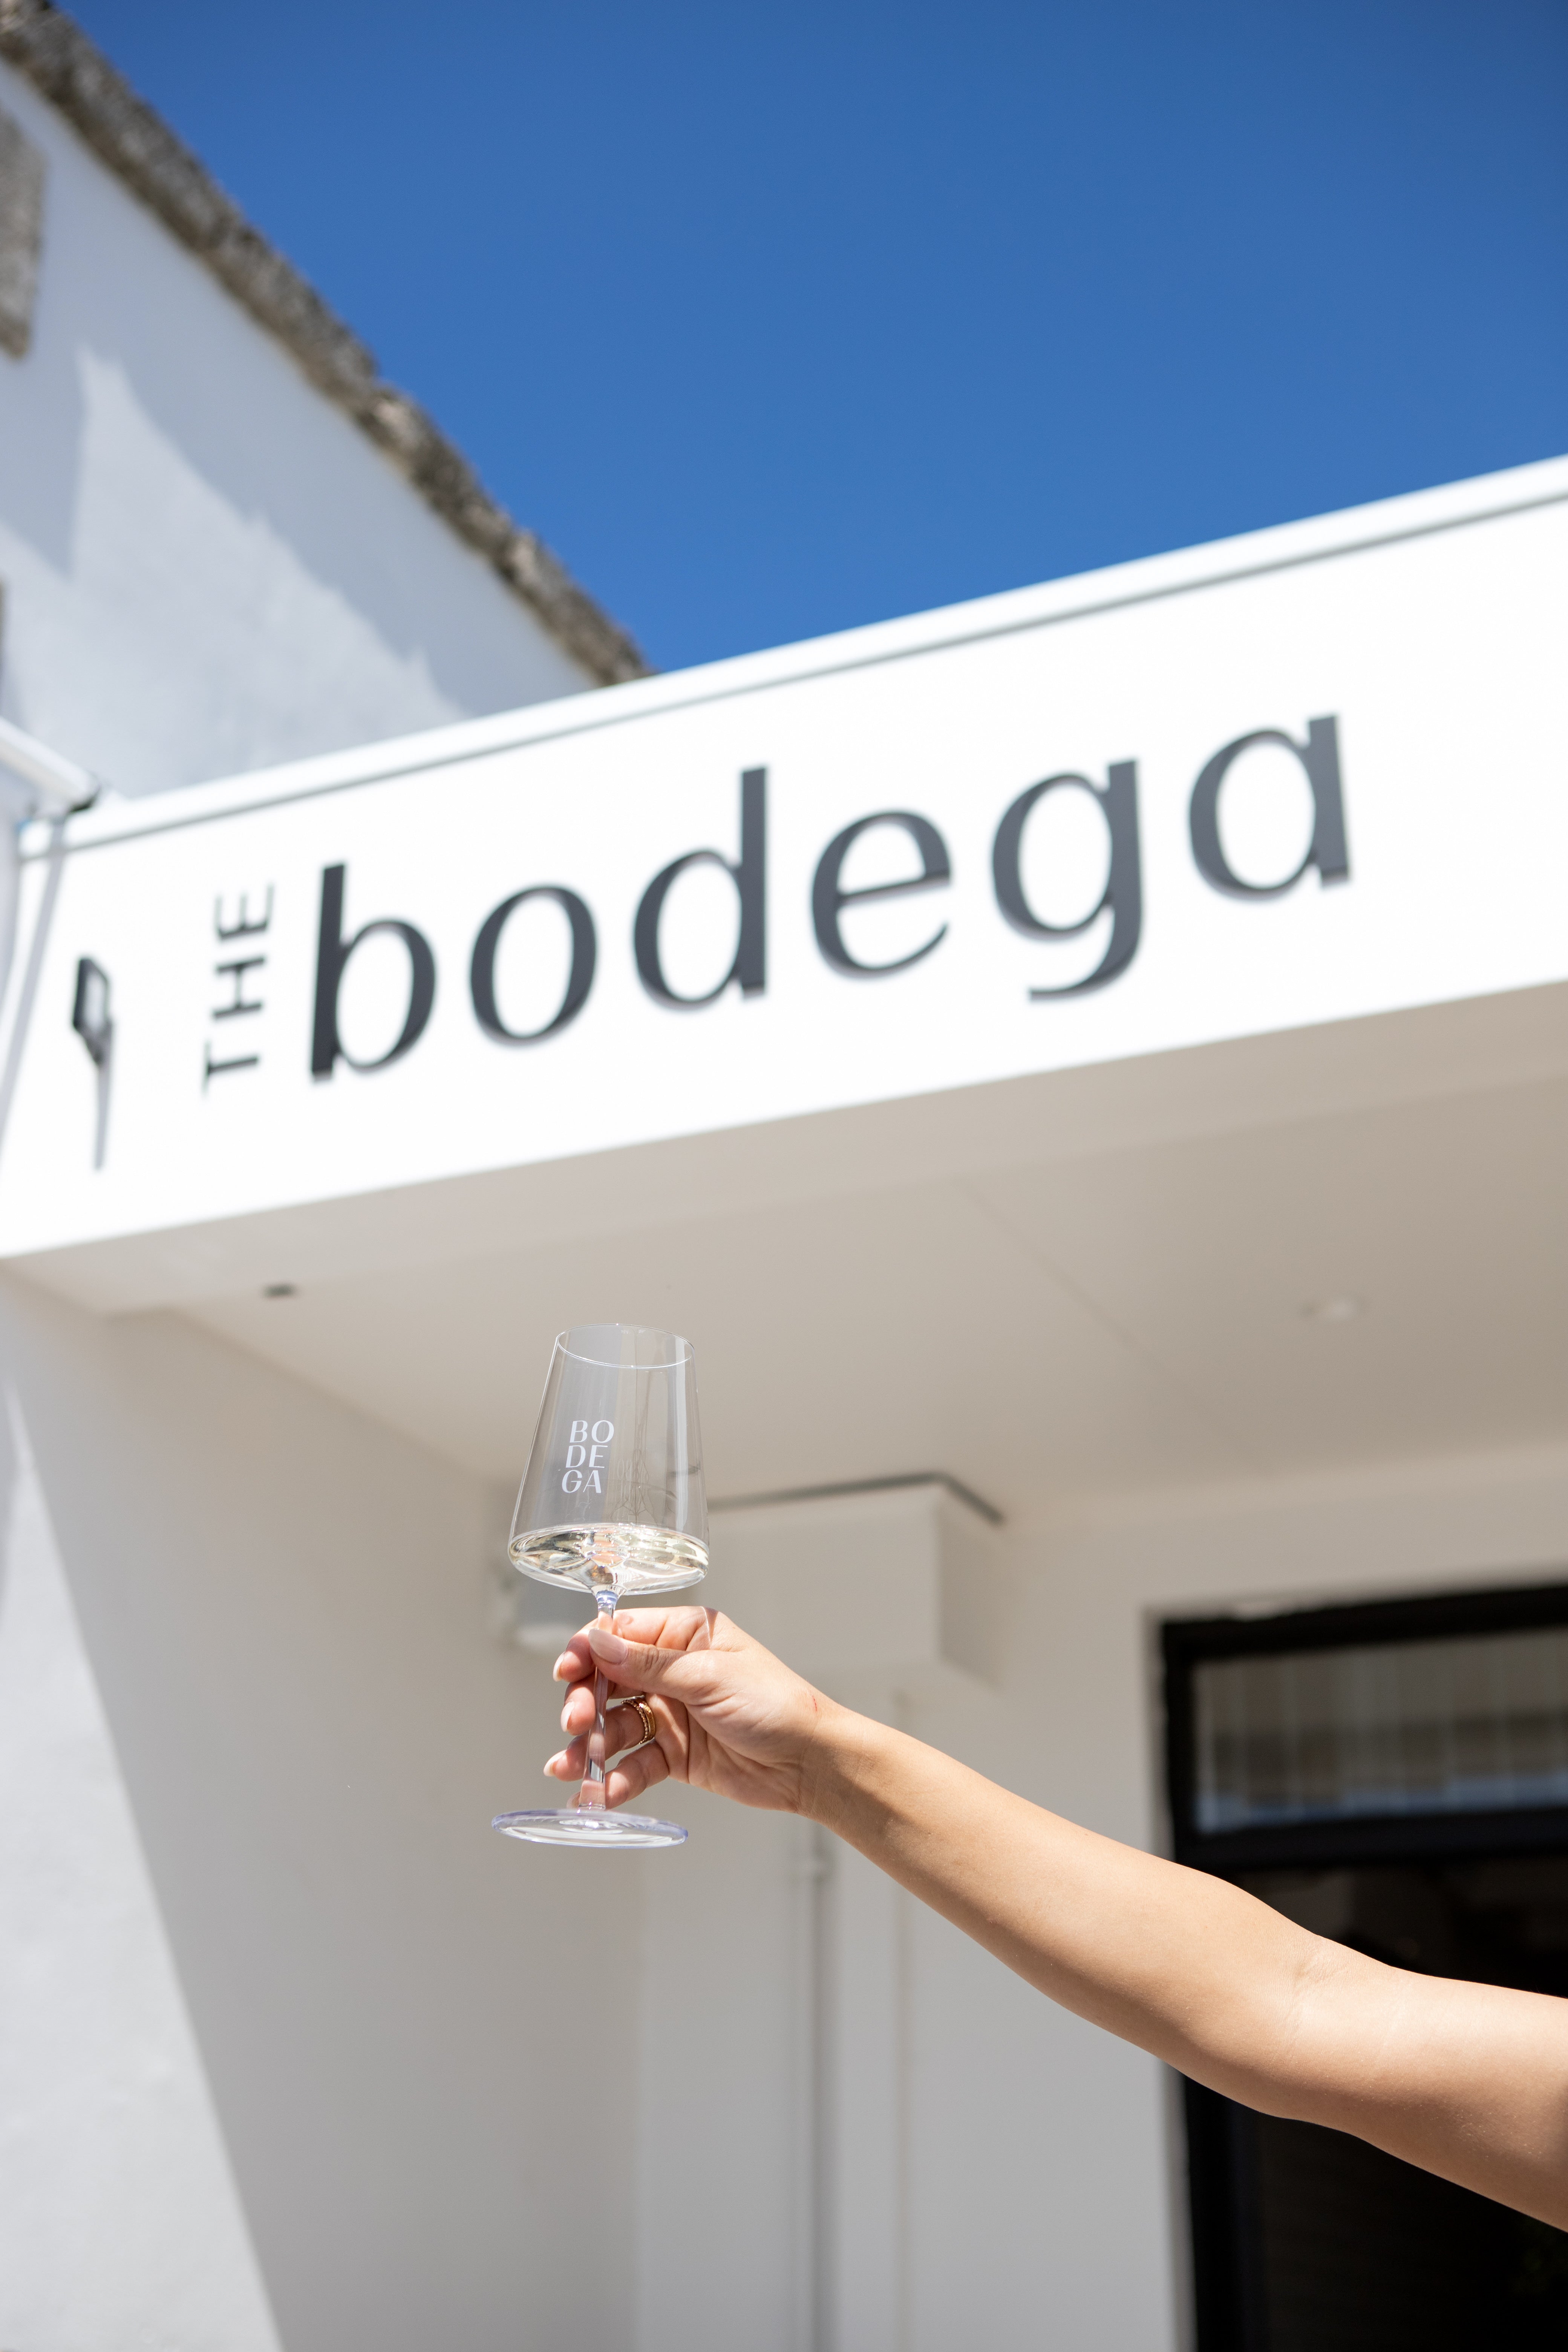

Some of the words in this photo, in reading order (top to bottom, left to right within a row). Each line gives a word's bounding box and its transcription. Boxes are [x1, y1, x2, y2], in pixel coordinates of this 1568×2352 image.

[308, 712, 1353, 1084] bodega
[201, 882, 274, 1096] THE
[570, 1420, 614, 1443] BO
[565, 1445, 608, 1468] DE
[562, 1470, 602, 1493] GA
